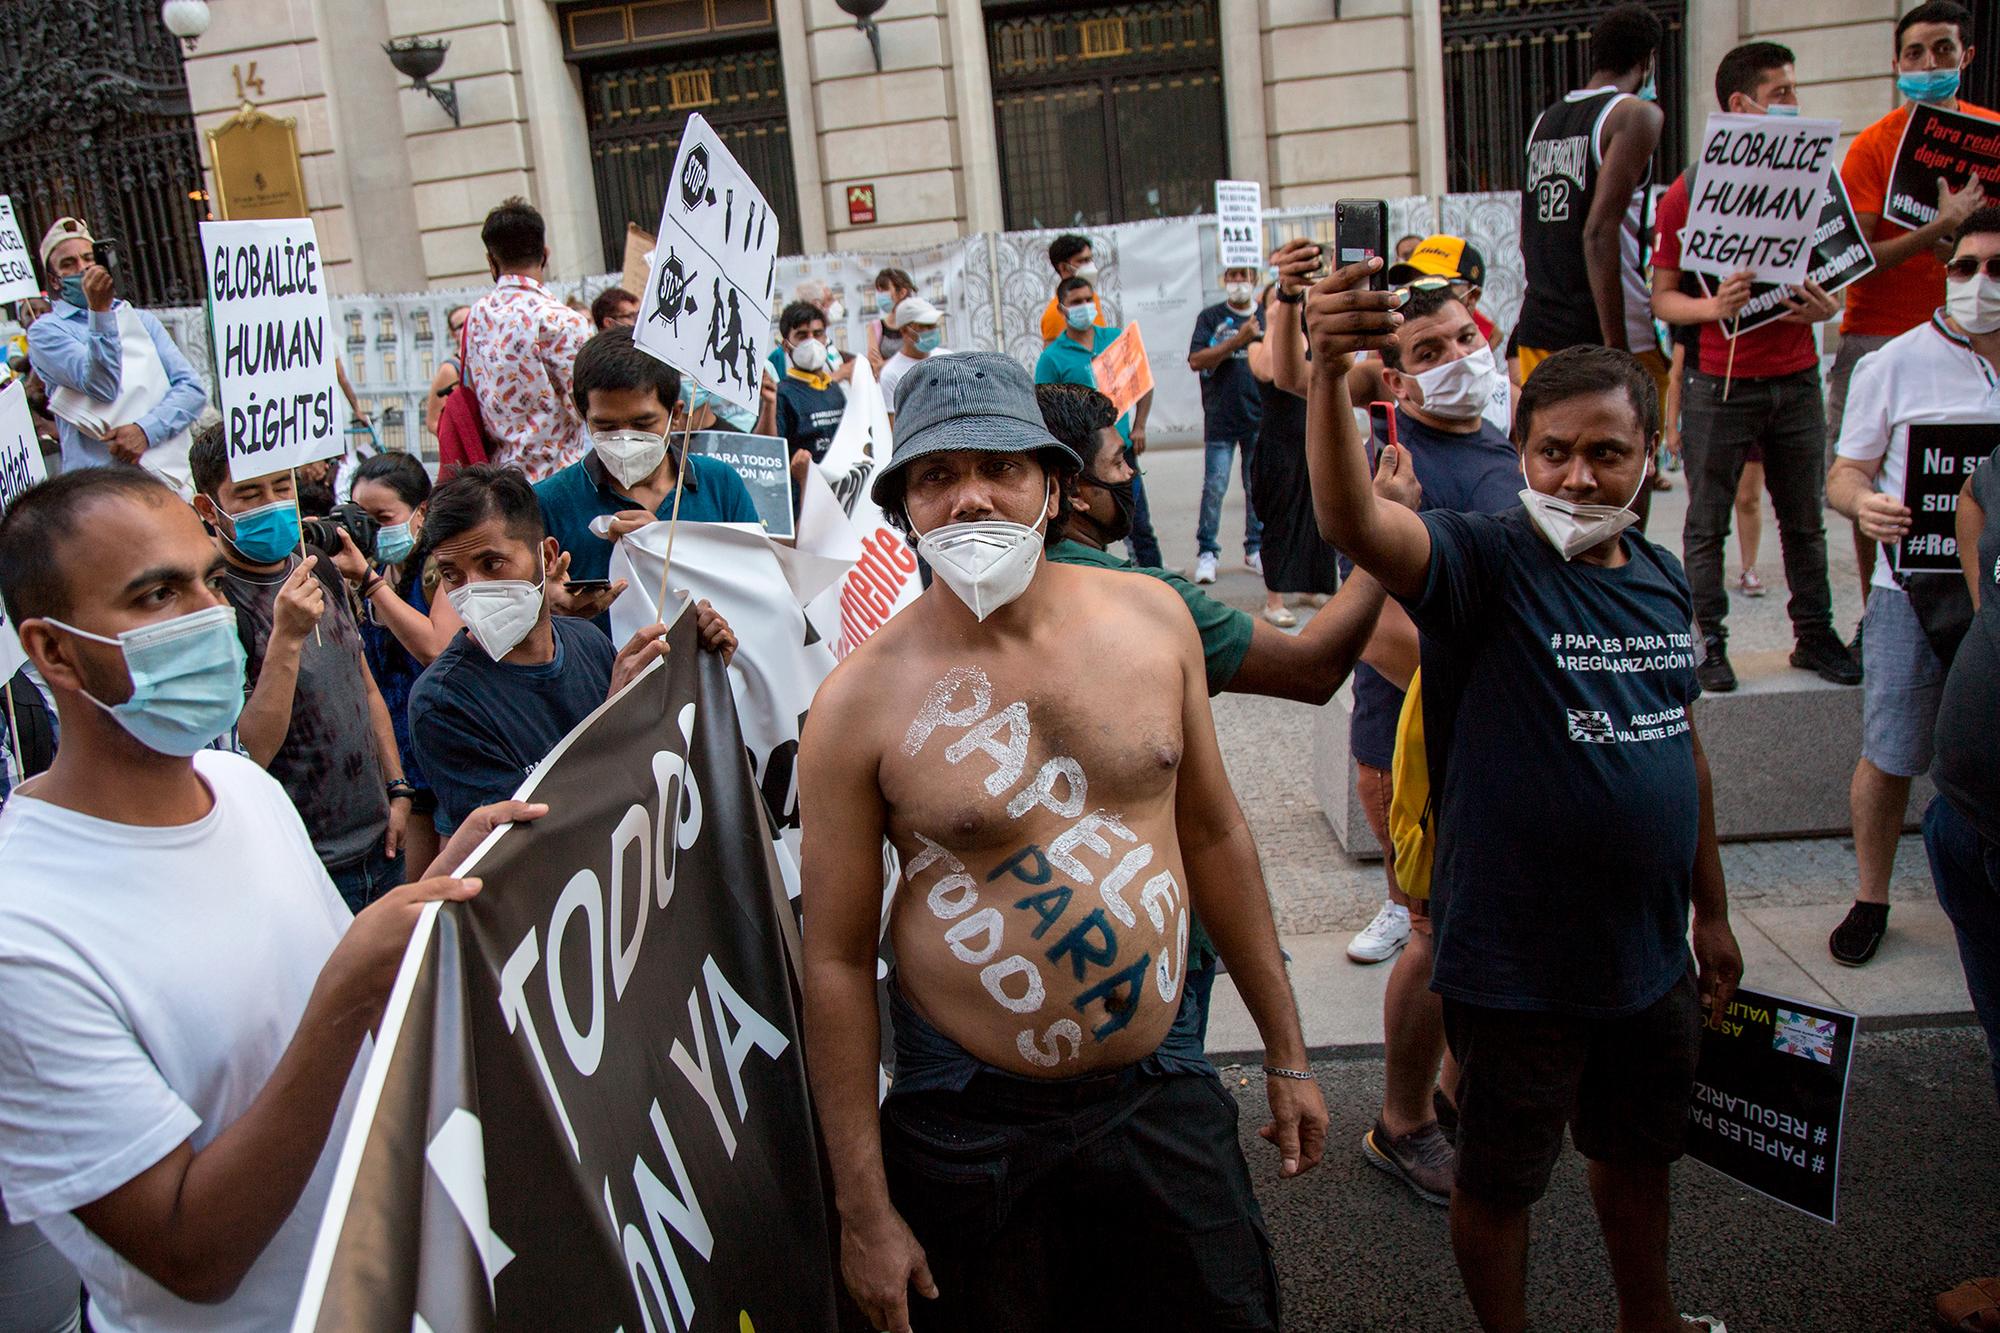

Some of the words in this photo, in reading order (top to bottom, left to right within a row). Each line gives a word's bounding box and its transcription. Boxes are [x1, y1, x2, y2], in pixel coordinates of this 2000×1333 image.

[231, 61, 265, 98] 14
[683, 154, 707, 196] STOP
[1538, 179, 1570, 222] 92
[1696, 179, 1816, 221] HUMAN
[1685, 224, 1807, 269] RIGHTS!
[224, 315, 324, 379] HUMAN
[230, 385, 334, 459] RIGHTS!
[741, 454, 783, 469] TODOS
[759, 469, 775, 481] YA
[1922, 447, 1955, 475] No
[1625, 635, 1667, 652] PARA
[1615, 726, 1667, 742] VALIENTE
[903, 664, 1189, 1004] PAPELES
[905, 831, 1082, 1068] TODOS
[986, 844, 1152, 1043] PARA
[669, 954, 790, 1162] YA
[1692, 1080, 1809, 1140] REGULARIZ
[1718, 1117, 1807, 1169] PAPELES
